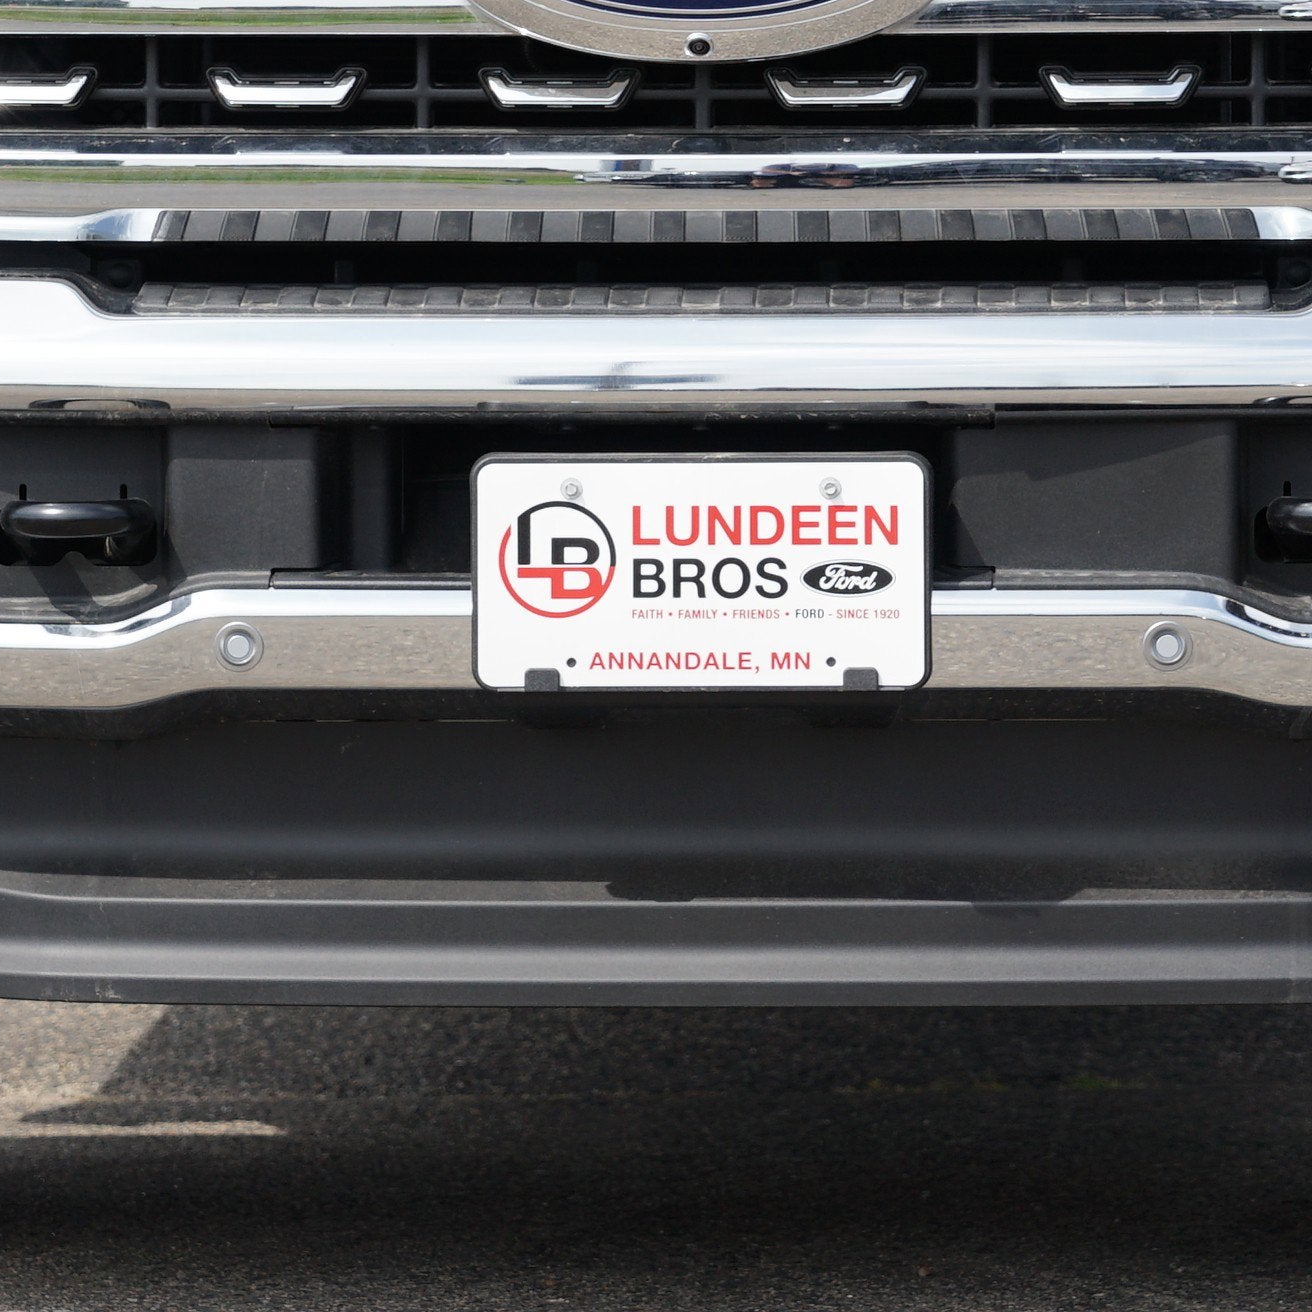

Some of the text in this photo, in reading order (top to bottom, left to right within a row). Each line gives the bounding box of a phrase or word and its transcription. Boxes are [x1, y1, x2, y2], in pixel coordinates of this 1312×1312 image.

[632, 504, 899, 546] LUNDEEN
[632, 557, 789, 599] BROS
[819, 563, 878, 590] Ford
[632, 609, 900, 620] FAITH FAMILY FRIENDS FORD SINCE 1920
[589, 651, 811, 674] ANNANDALE, MN
